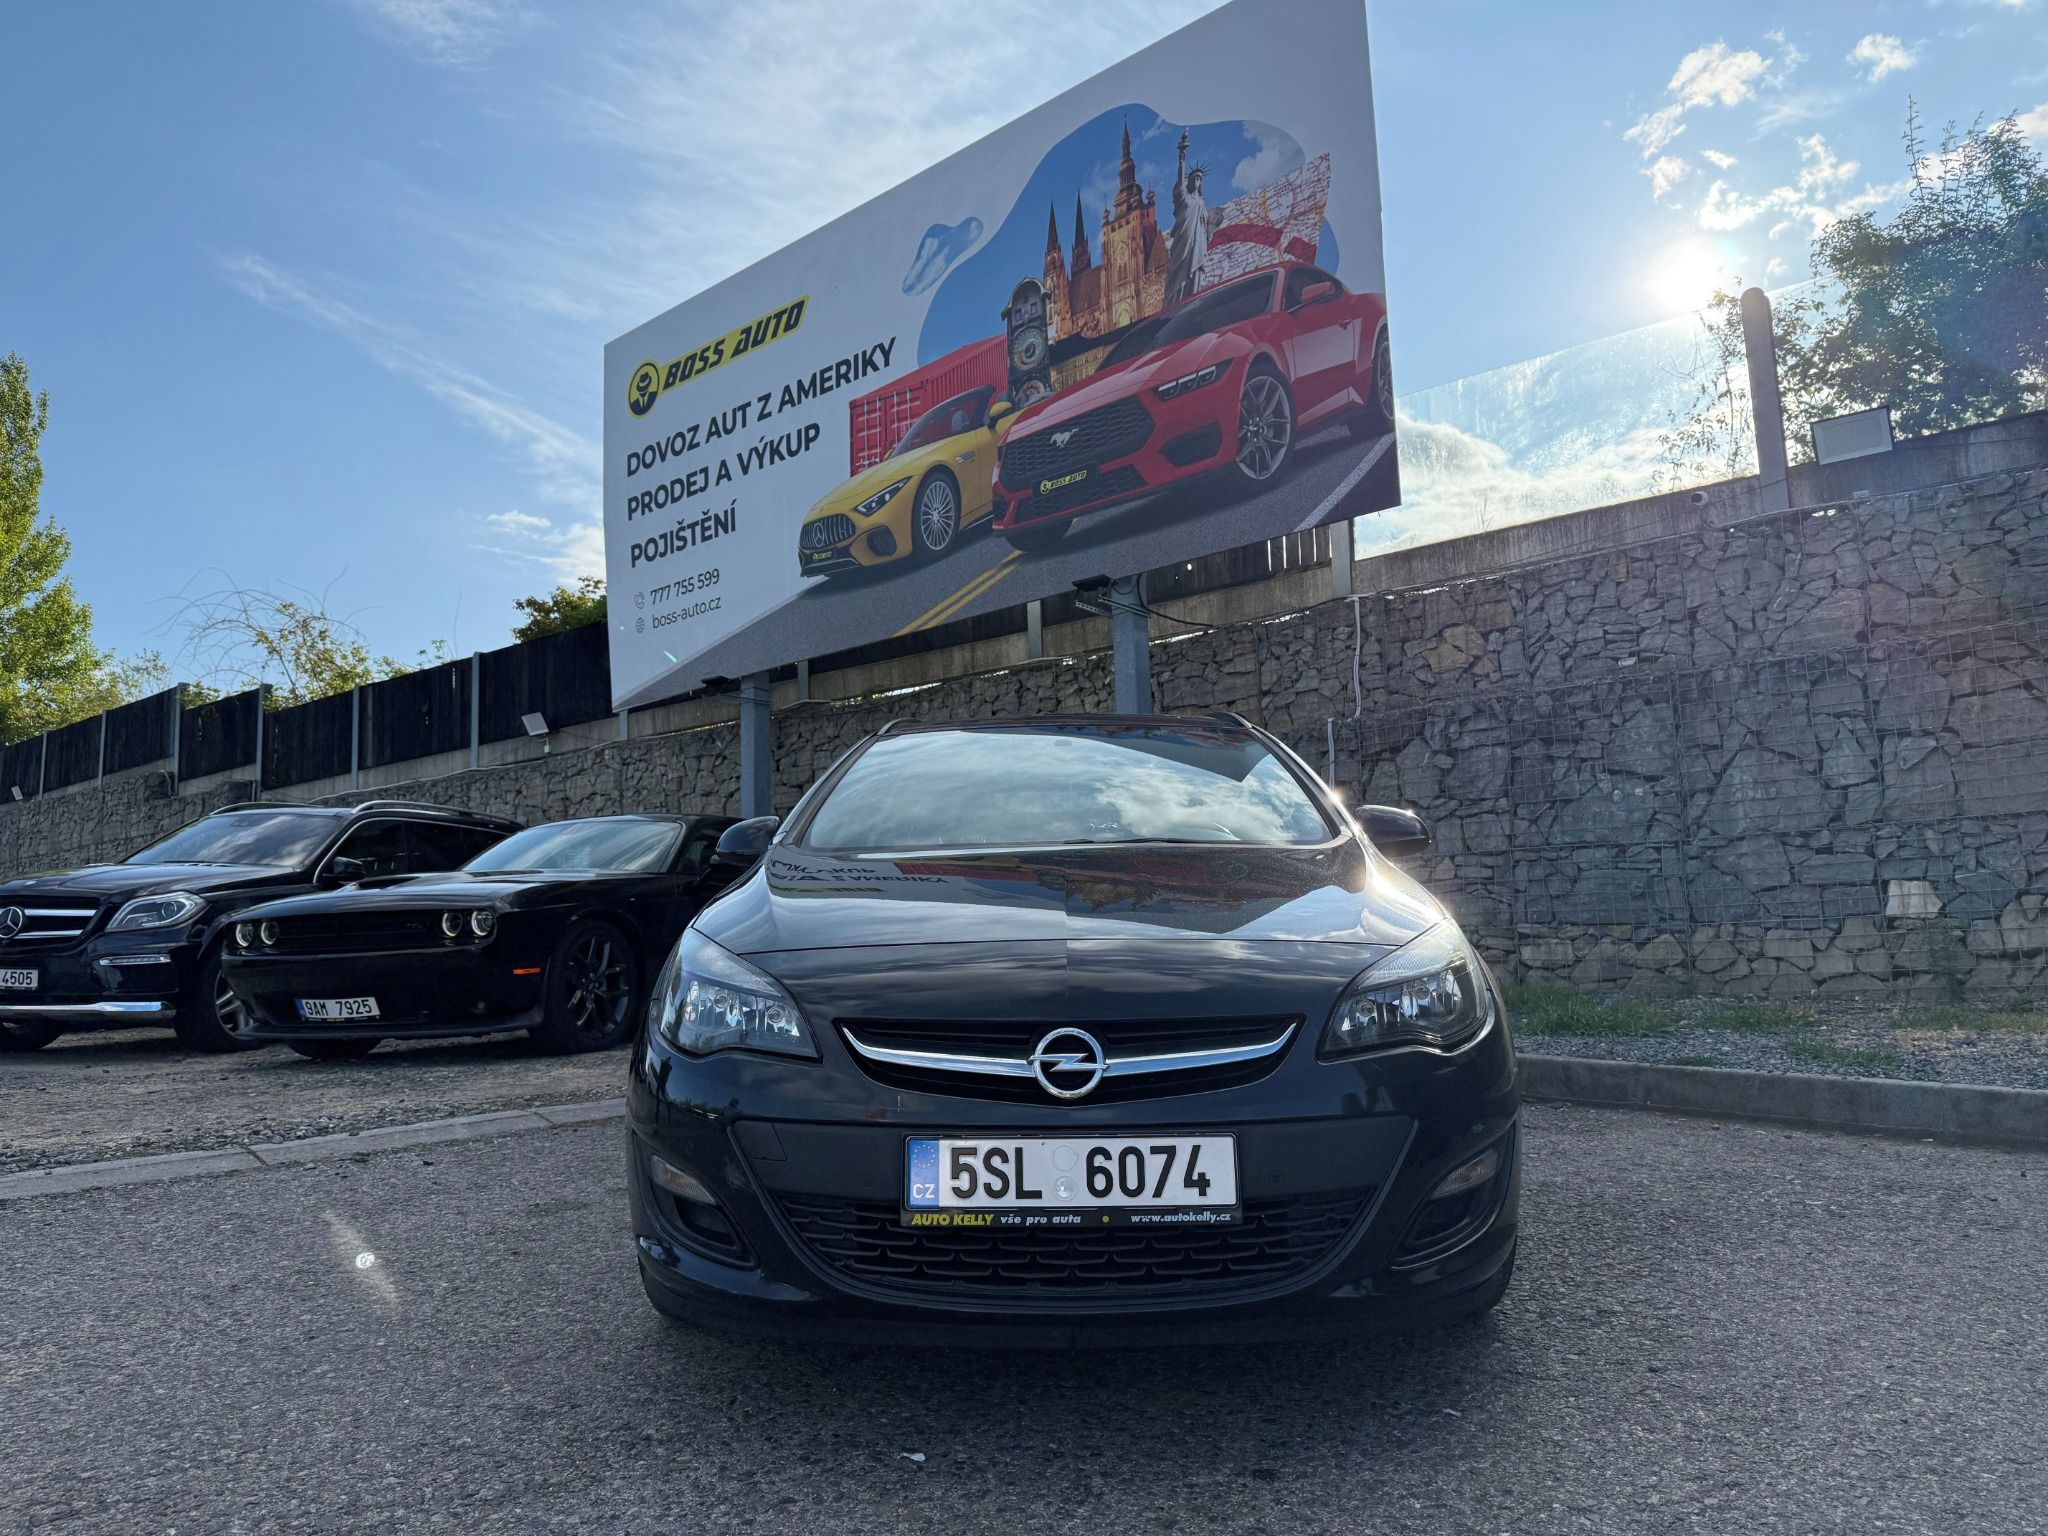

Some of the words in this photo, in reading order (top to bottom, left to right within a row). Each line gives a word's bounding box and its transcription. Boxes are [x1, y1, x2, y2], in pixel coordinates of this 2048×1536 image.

[662, 338, 727, 391] BOSS
[730, 299, 805, 359] AUTO
[626, 423, 701, 478] DOVOZ
[704, 401, 752, 445] AUT
[756, 391, 772, 423] Z
[777, 336, 897, 414] AMERIKY
[627, 465, 709, 521] PRODEJ
[714, 459, 733, 487] A
[736, 422, 821, 476] VÝKUP
[630, 498, 738, 569] POJIŠTĚNÍ
[650, 584, 672, 605] 777
[673, 576, 695, 598] 755
[697, 568, 720, 590] 599
[652, 596, 722, 629] boss-auto.cz
[2, 970, 33, 986] 4505
[304, 1001, 329, 1017] 9AM
[335, 999, 373, 1017] 7925
[950, 1145, 1043, 1200] 5SL
[1085, 1144, 1211, 1199] 6074
[912, 1183, 936, 1200] CZ
[911, 1214, 951, 1226] AUTO
[953, 1214, 995, 1226] KELLY
[1000, 1214, 1022, 1225] vše
[1026, 1216, 1048, 1227] pro
[1052, 1214, 1082, 1225] auta
[1131, 1211, 1232, 1224] www.autokelly.cz
